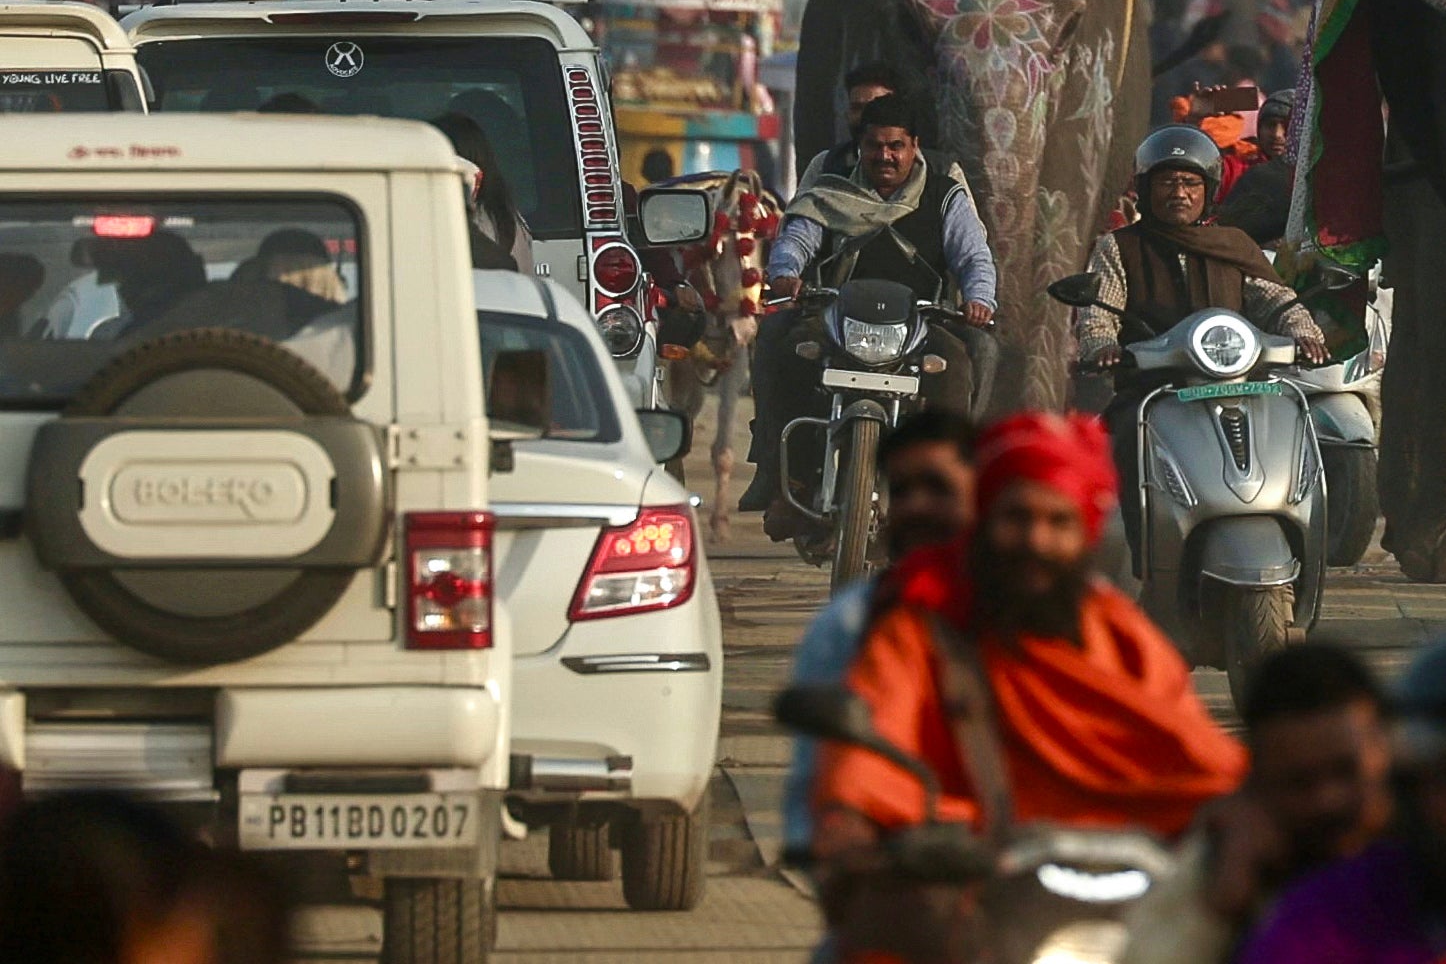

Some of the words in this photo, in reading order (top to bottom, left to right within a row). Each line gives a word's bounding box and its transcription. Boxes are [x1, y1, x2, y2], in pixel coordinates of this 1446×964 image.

[2, 73, 41, 85] YOUNG
[44, 73, 70, 84] LIVE
[71, 73, 101, 84] FREE
[133, 476, 274, 520] BOLERO
[268, 804, 469, 839] PB11BD0207
